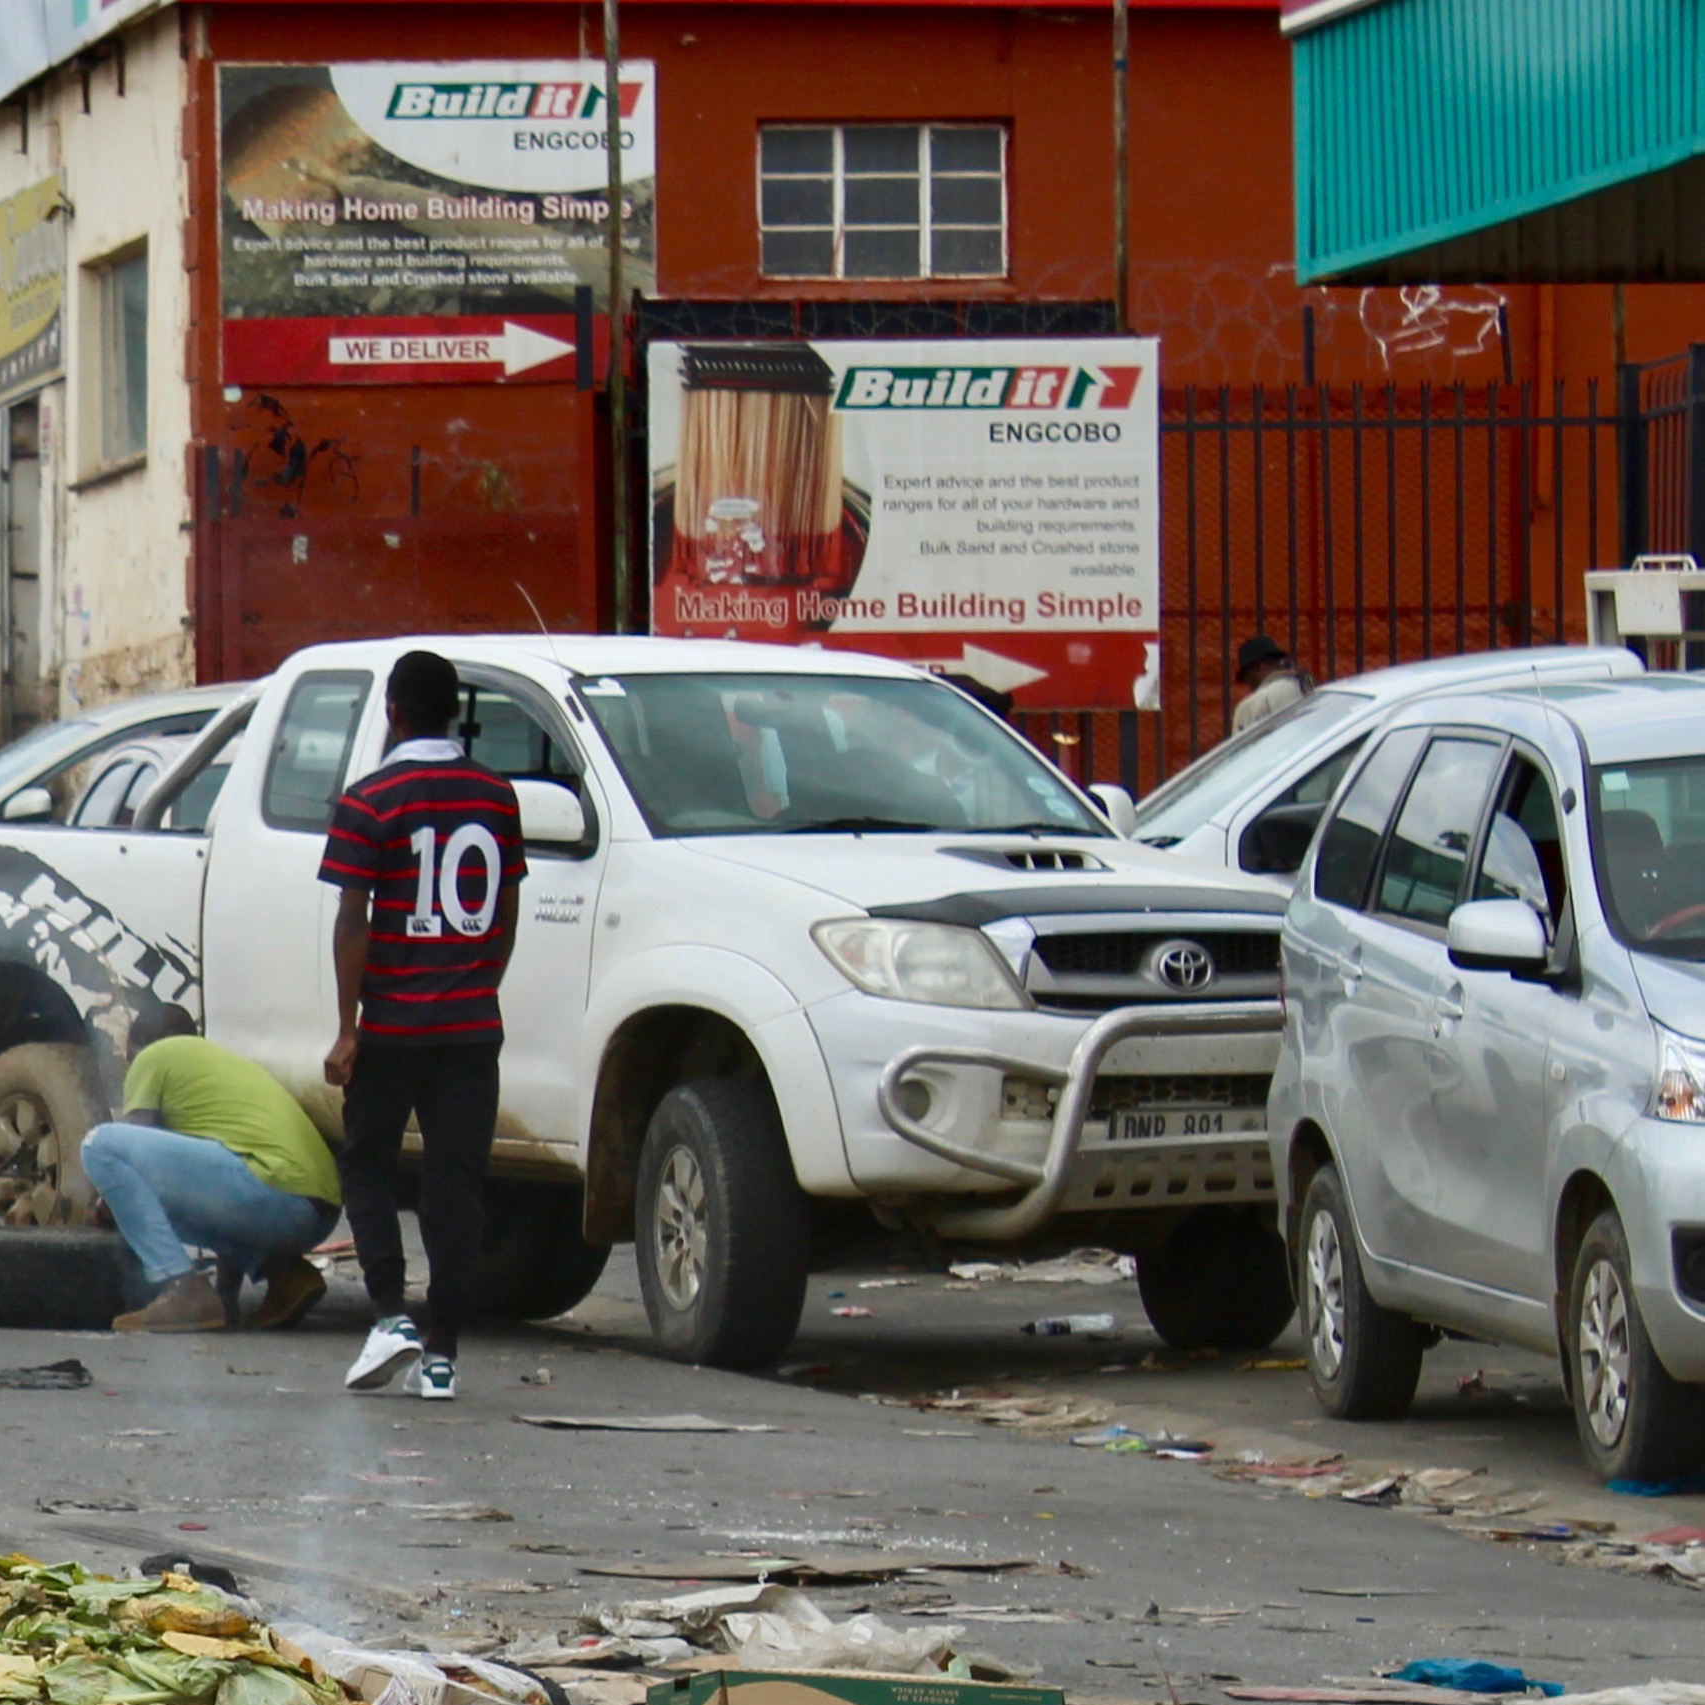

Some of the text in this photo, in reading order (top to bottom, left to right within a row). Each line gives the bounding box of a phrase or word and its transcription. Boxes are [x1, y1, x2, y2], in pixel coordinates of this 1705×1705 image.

[393, 85, 573, 118] Build it
[242, 195, 633, 227] Making Home Building Simpe
[232, 236, 282, 254] Expert
[285, 235, 333, 251] advice
[335, 235, 364, 250] and
[367, 235, 390, 250] the
[394, 235, 426, 250] best
[429, 235, 486, 252] product
[489, 237, 539, 252] ranges
[542, 235, 563, 249] for
[588, 235, 604, 249] of
[304, 254, 373, 269] hardware
[376, 254, 403, 268] and
[407, 254, 467, 270] building
[293, 271, 581, 287] Bulk Sand and Crushed stone available.
[346, 340, 489, 361] WE DELIVER
[845, 369, 1059, 407] Build it
[989, 422, 1121, 443] ENGCOBO
[884, 475, 1139, 491] Expert advice and the best product
[883, 497, 1139, 514] ranges for all of your hardware and
[977, 519, 1033, 535] building
[920, 541, 1140, 556] Bulk Sand and Crushed stone
[676, 590, 1142, 624] Making Home Building Simple
[406, 822, 502, 938] 10
